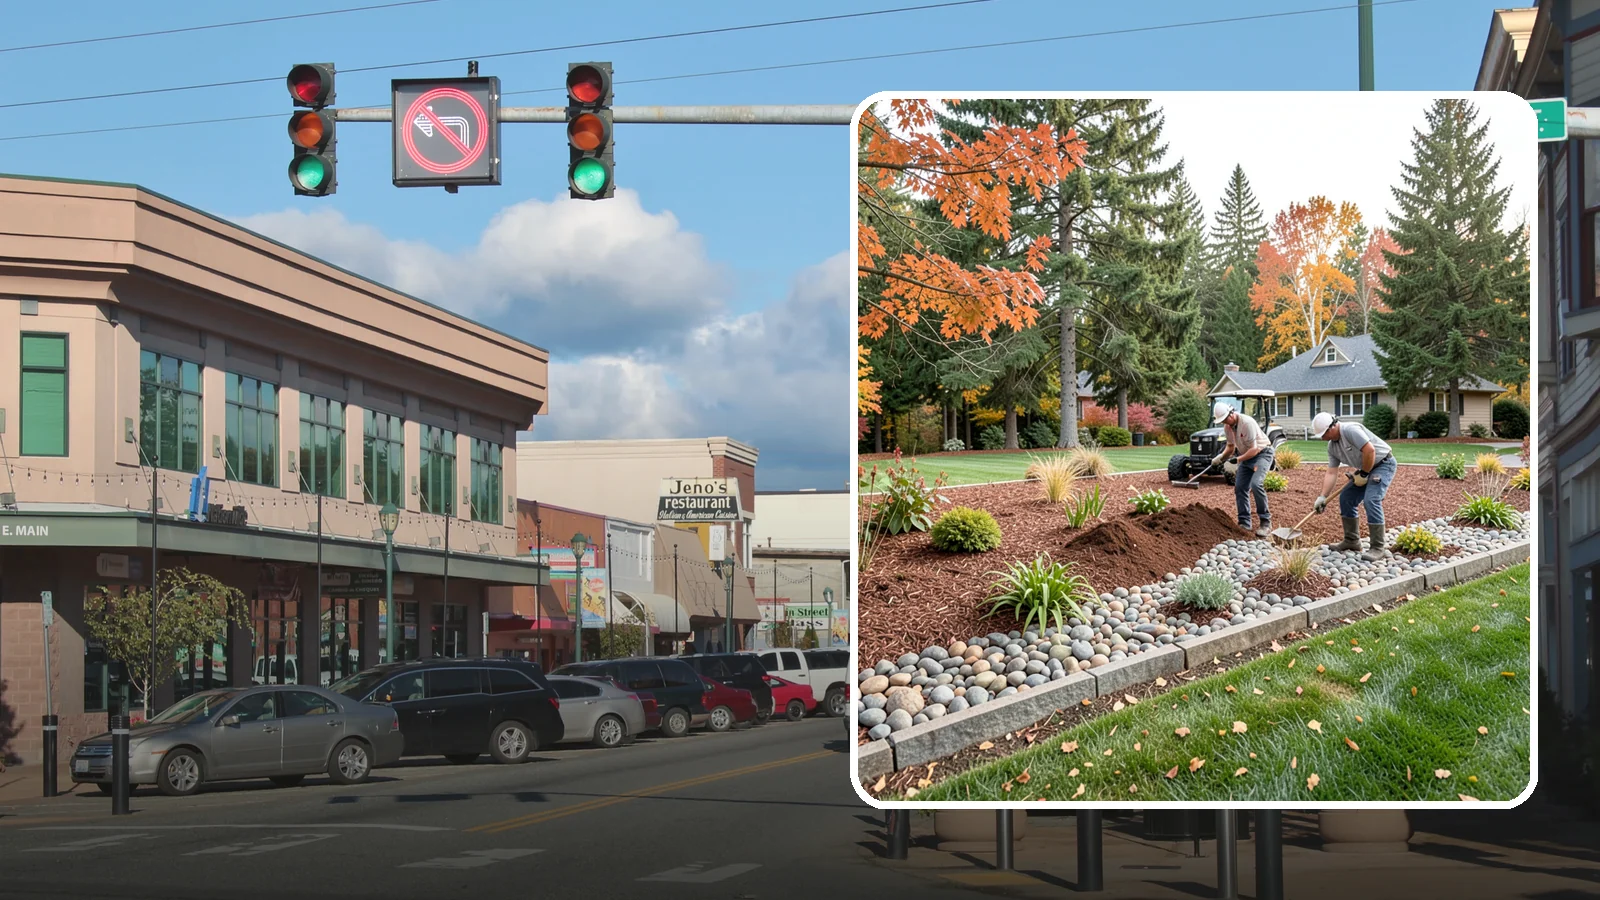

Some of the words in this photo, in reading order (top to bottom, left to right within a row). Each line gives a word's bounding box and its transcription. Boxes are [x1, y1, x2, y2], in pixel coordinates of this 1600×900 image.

[670, 480, 727, 494] Jeno's
[665, 497, 730, 509] restaurant
[658, 510, 681, 519] Italian
[686, 510, 714, 519] American
[715, 509, 737, 519] Cuisine
[2, 525, 13, 536] E.
[15, 525, 49, 536] MAIN
[785, 608, 794, 617] in
[797, 608, 828, 616] Street
